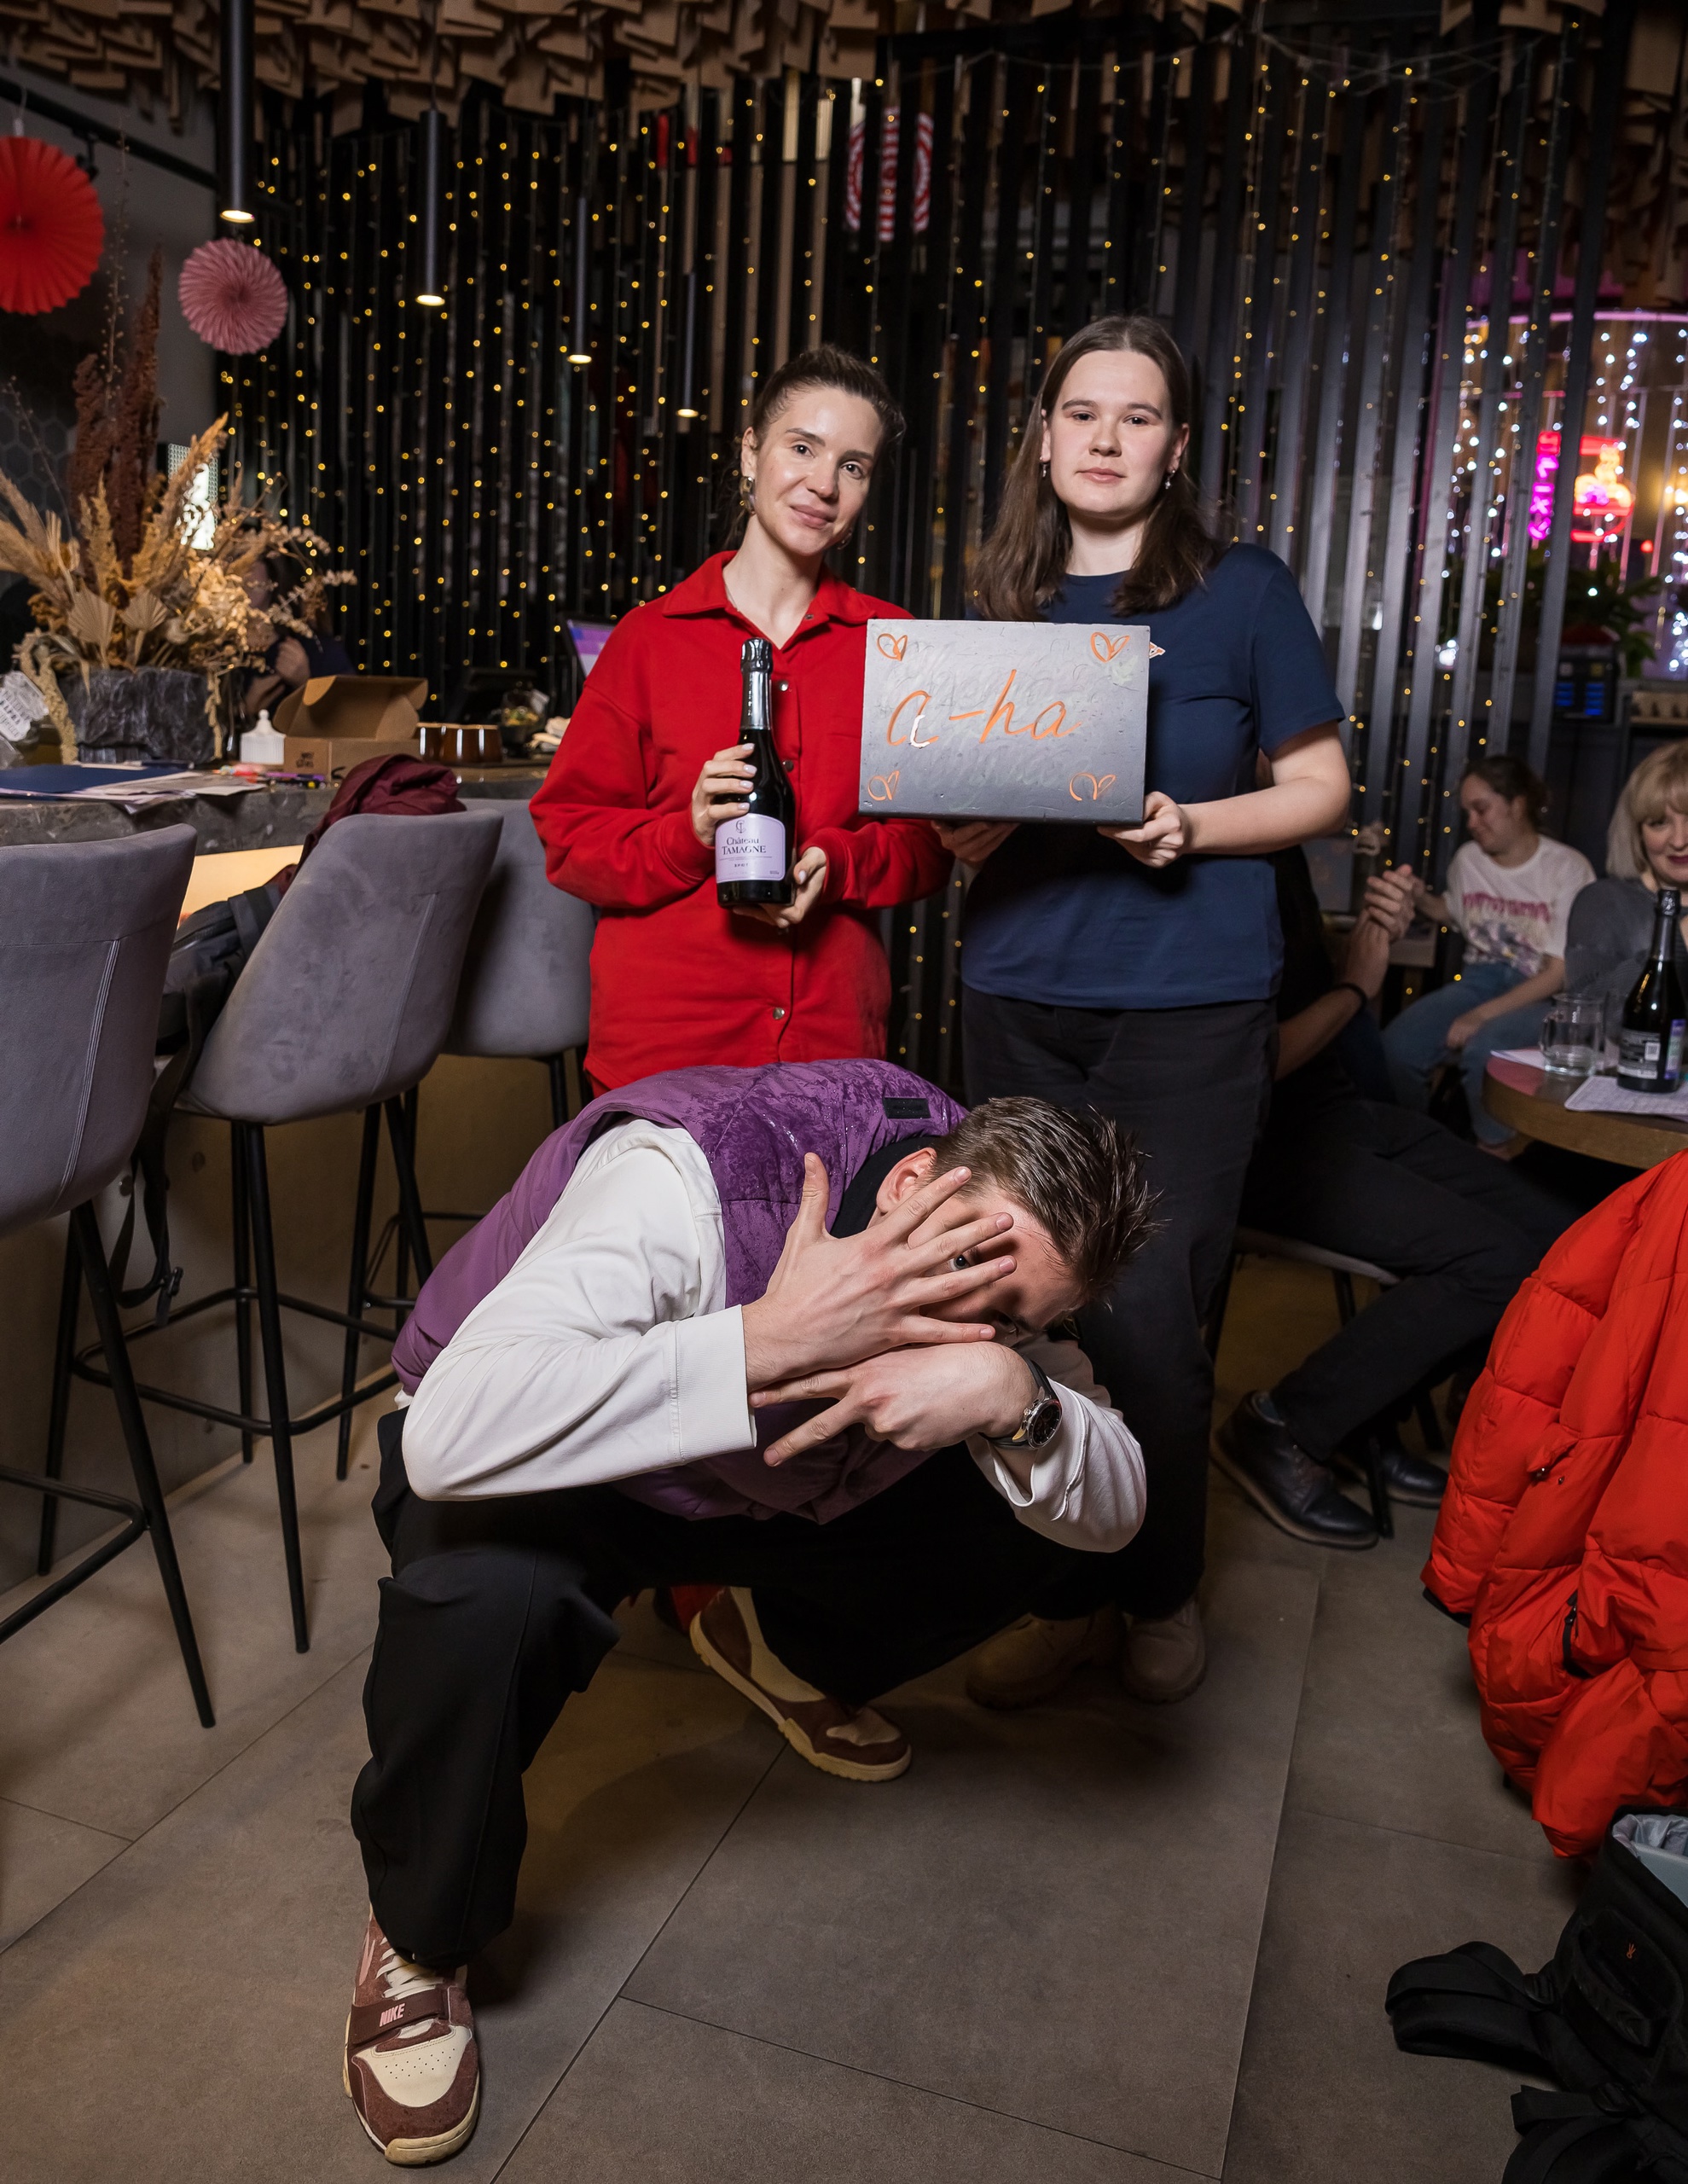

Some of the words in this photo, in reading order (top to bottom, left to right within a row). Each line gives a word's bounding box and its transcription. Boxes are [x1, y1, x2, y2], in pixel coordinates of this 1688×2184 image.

[885, 668, 1083, 749] a-ha
[726, 836, 759, 845] Château
[722, 845, 767, 856] TAMAGNE
[379, 2002, 406, 2027] NIKE
